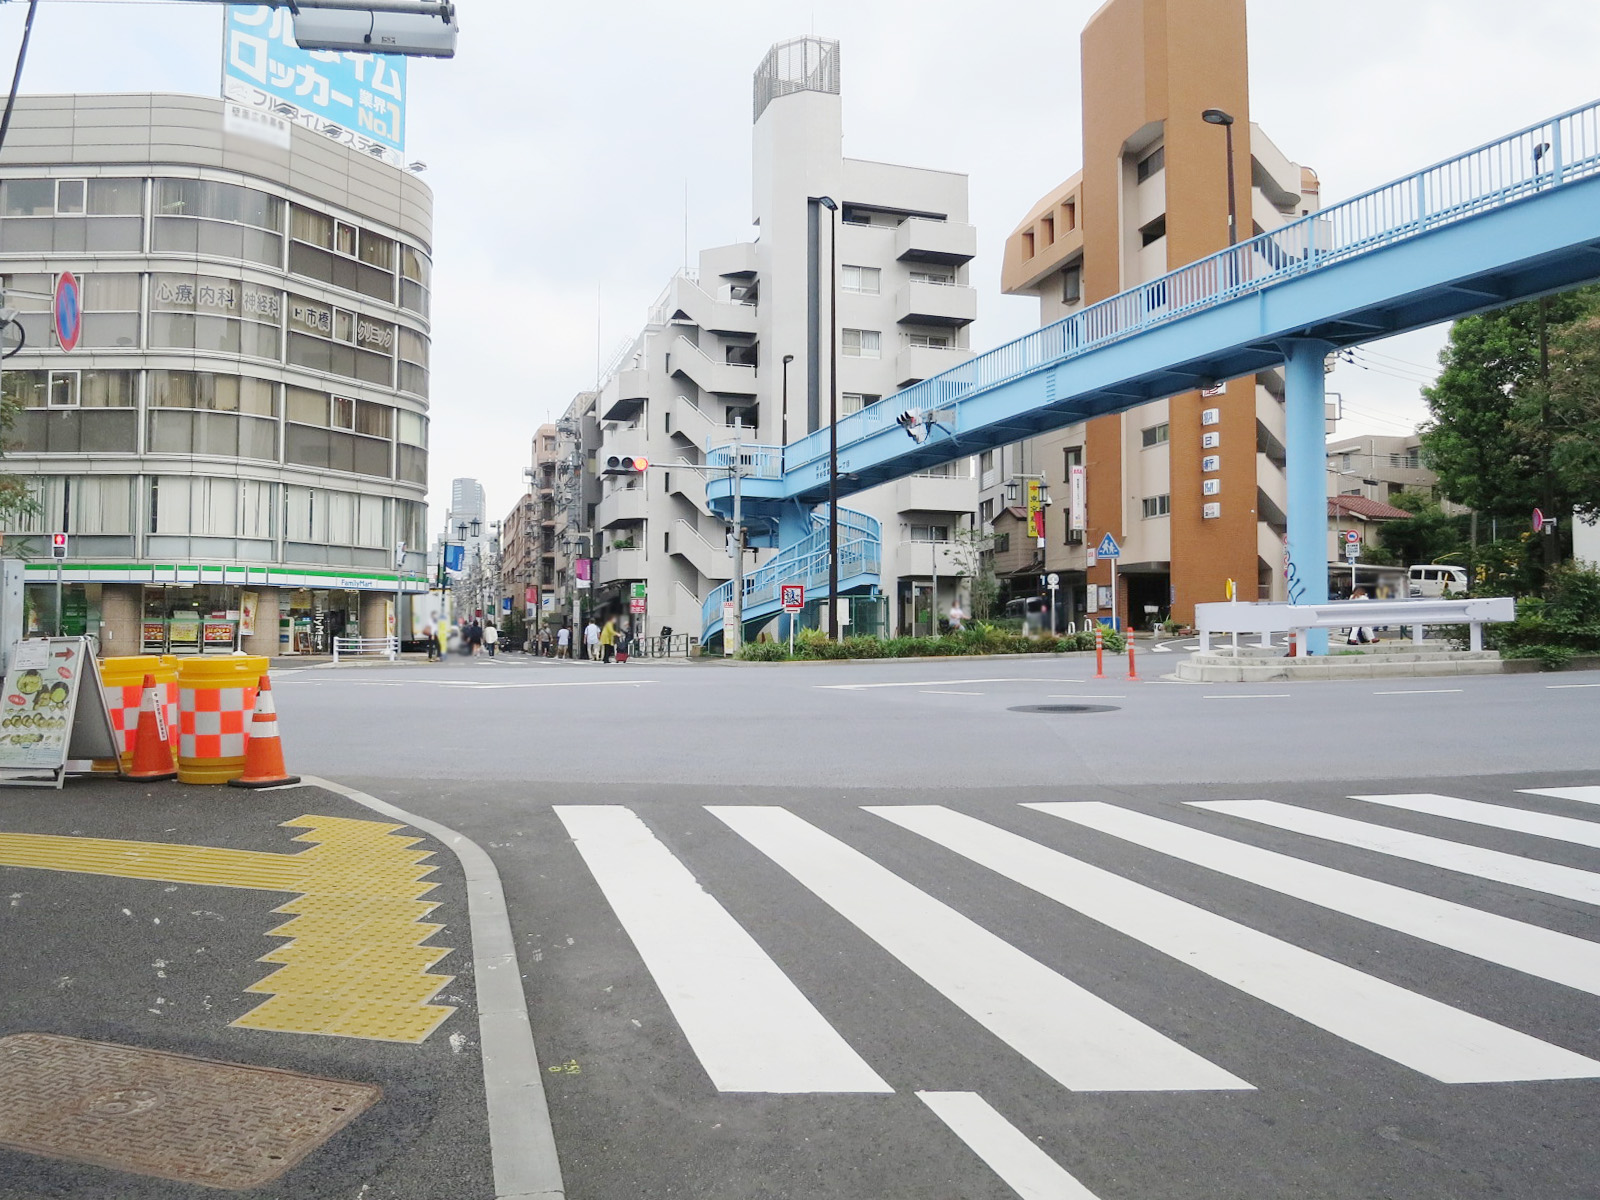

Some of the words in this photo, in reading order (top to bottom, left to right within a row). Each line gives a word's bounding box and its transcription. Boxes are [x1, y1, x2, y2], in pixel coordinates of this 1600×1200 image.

[230, 29, 354, 107] ロッカー
[359, 87, 387, 115] 業界
[357, 101, 401, 143] No.1
[156, 283, 234, 308] 心療内科
[341, 579, 373, 588] FamilyMart
